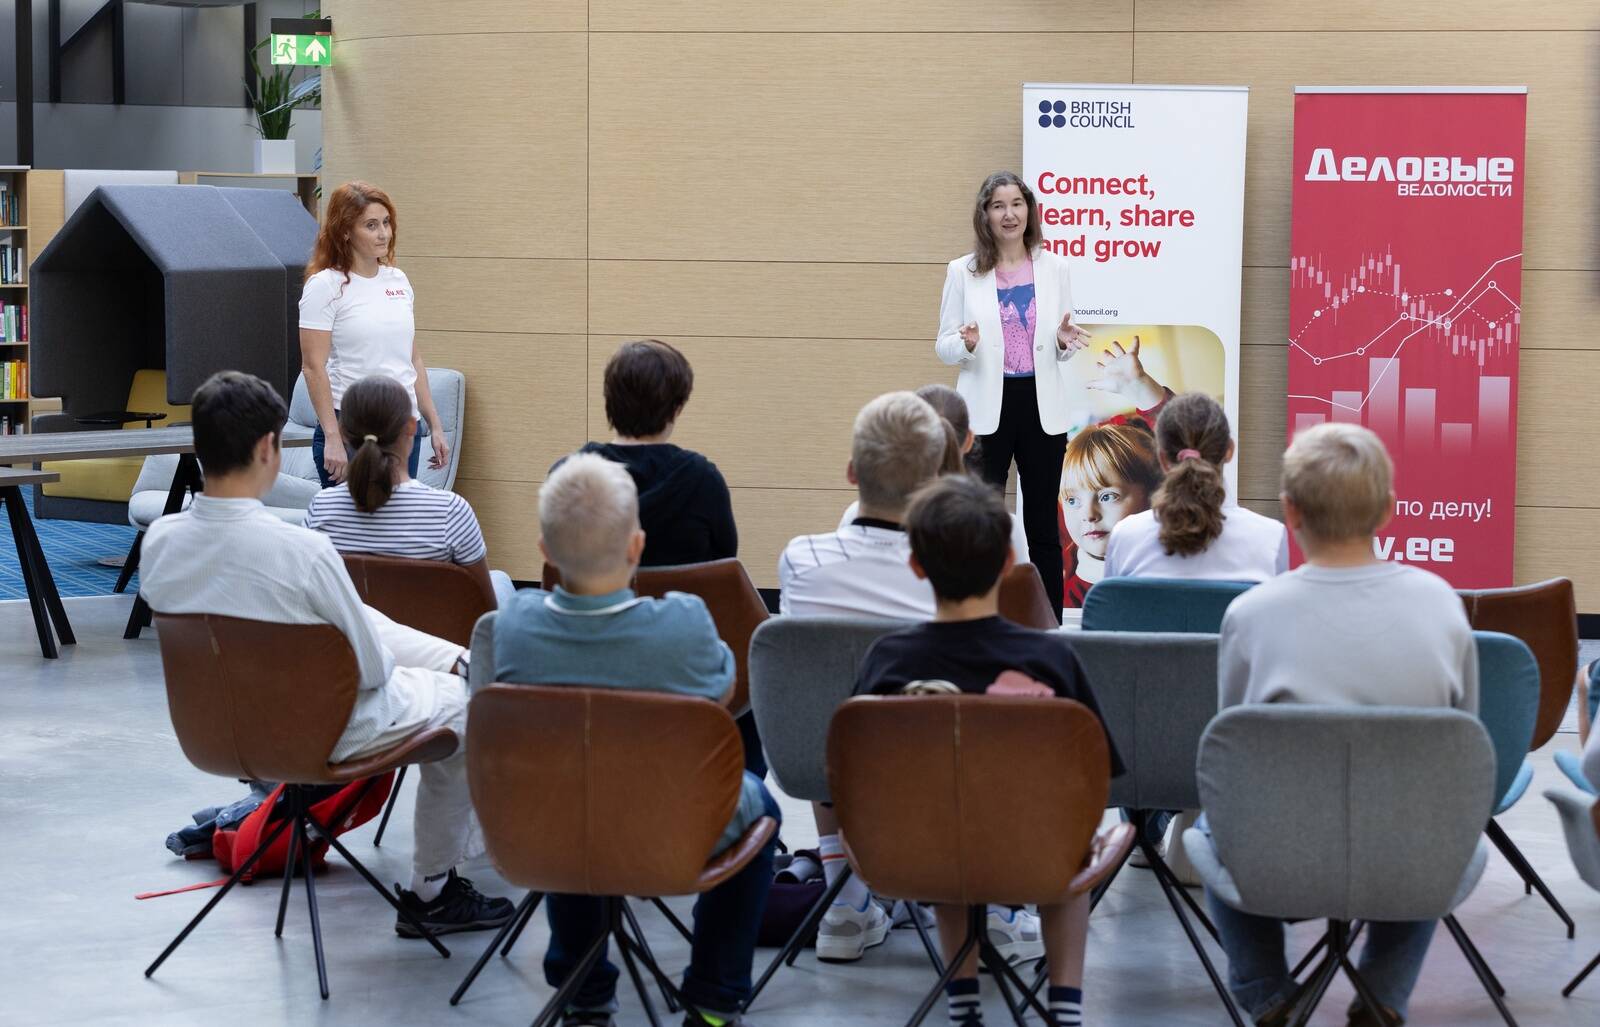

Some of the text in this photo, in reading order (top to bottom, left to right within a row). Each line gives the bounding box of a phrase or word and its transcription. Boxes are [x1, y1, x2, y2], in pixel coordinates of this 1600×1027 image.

[1071, 101, 1131, 114] BRITISH
[1070, 115, 1135, 128] COUNCIL
[1305, 148, 1514, 182] Деловые
[1038, 171, 1155, 200] Connect,
[1397, 183, 1512, 197] ВЕДОМОСТИ
[1119, 204, 1195, 227] share
[1094, 240, 1161, 263] grow
[1396, 498, 1491, 522] по делу!
[1372, 536, 1455, 562] v.ee
